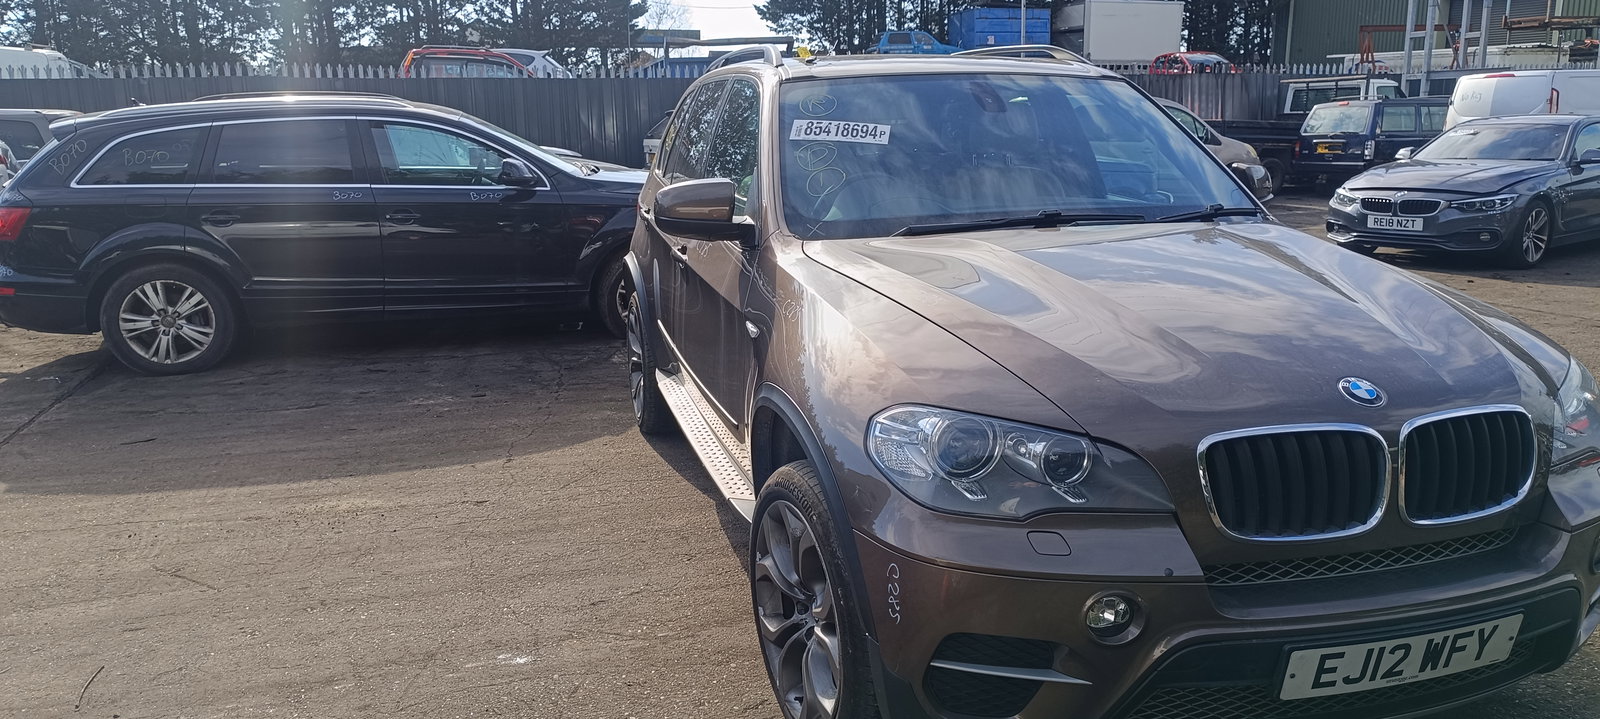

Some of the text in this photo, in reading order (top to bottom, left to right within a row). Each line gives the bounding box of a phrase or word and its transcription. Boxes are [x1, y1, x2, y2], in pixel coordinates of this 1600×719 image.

[1373, 217, 1417, 229] RE18 NZT
[1310, 624, 1500, 690] EJ12 WFY
